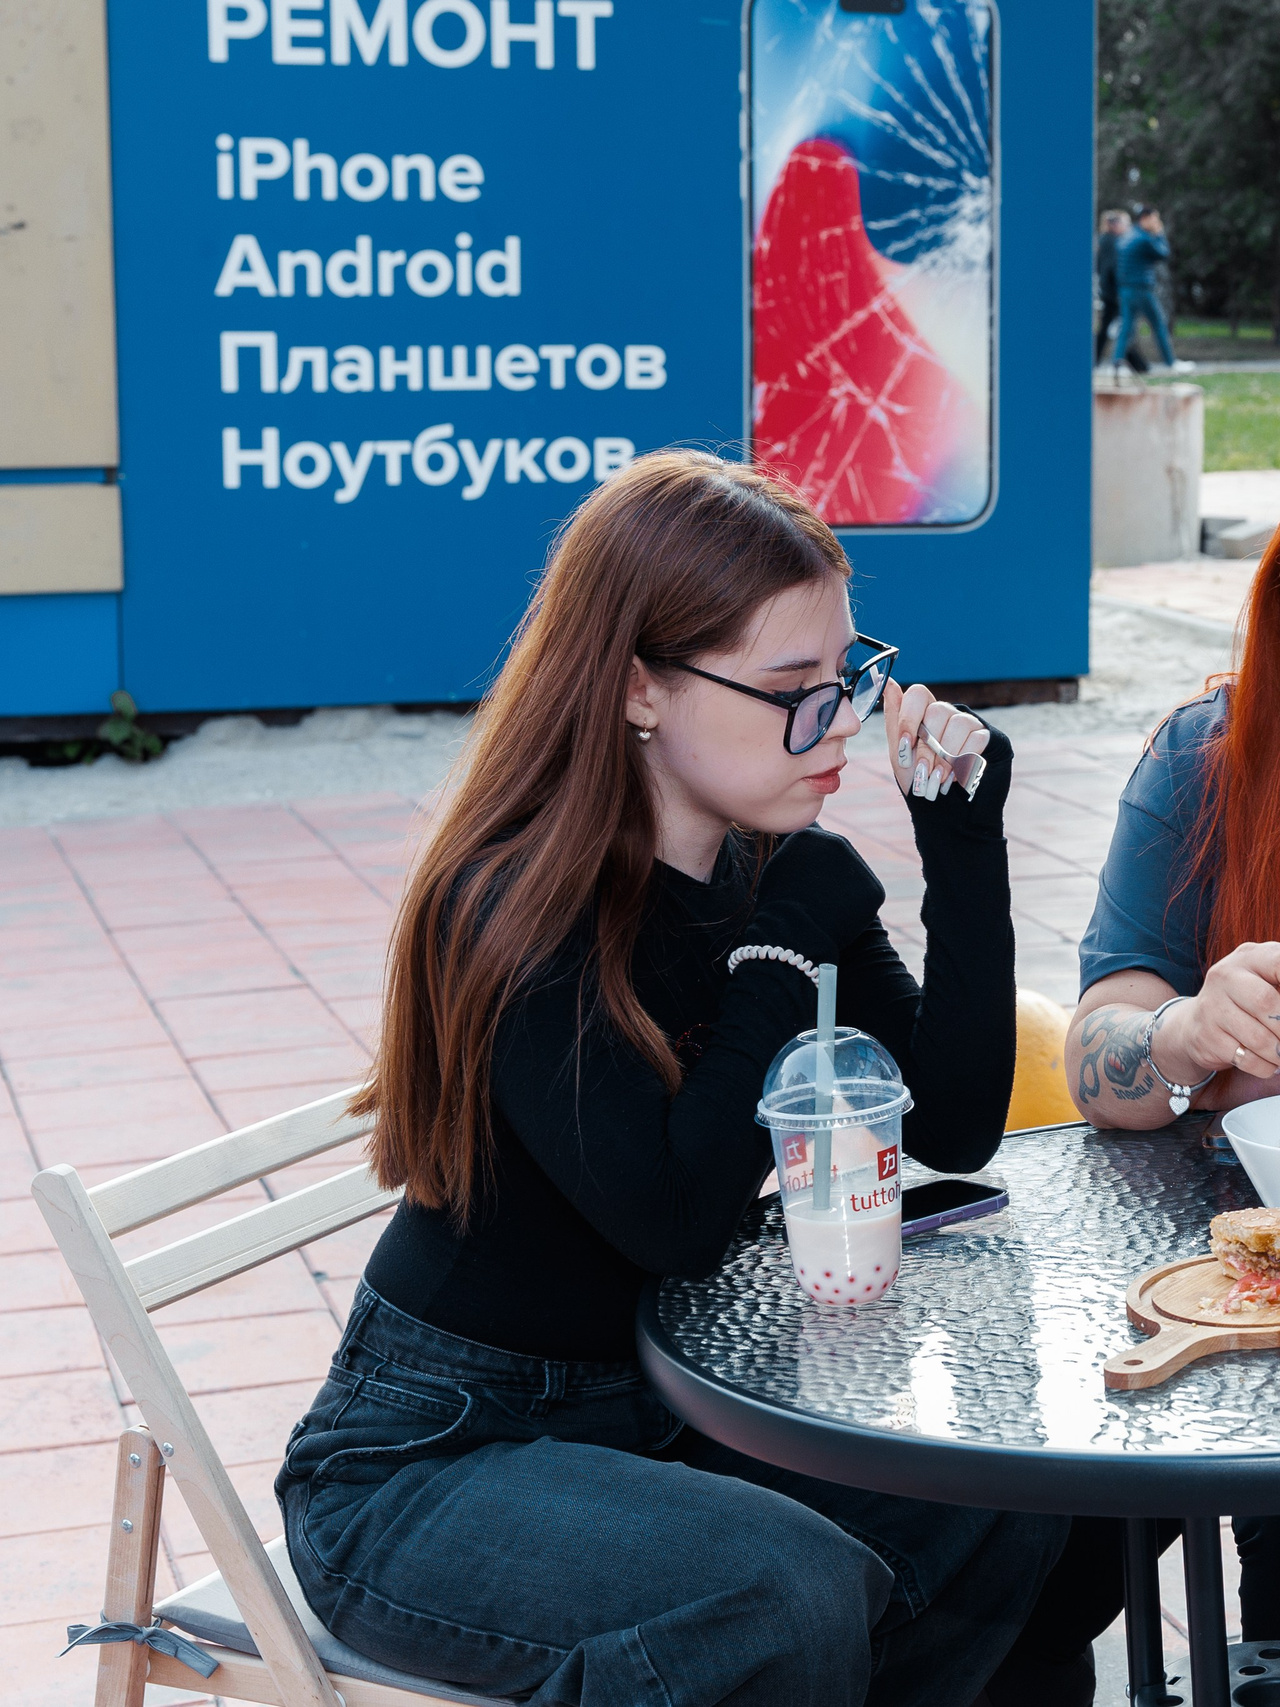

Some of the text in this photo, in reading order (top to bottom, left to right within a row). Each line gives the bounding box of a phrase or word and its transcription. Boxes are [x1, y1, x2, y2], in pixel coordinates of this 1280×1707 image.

[207, 0, 615, 71] РЕМОНТ
[215, 133, 485, 202] iPhone
[213, 232, 522, 298] Android
[219, 330, 668, 394] Планшетов
[222, 423, 637, 504] Ноутбуков
